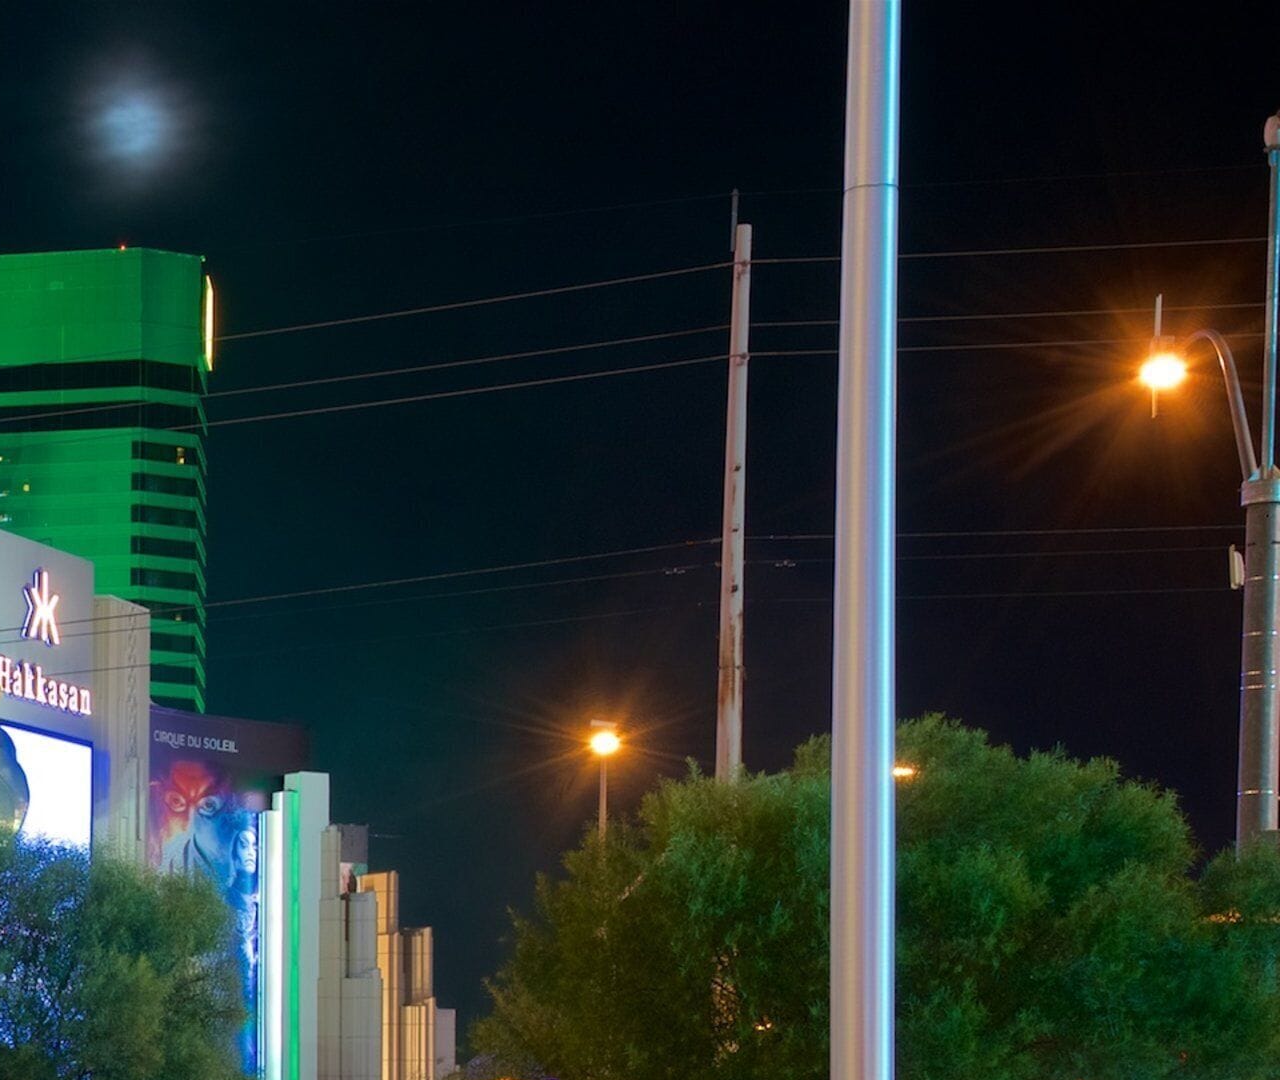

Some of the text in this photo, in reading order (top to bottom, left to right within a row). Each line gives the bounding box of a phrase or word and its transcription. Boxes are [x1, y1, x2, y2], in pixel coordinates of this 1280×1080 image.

[153, 729, 239, 753] CIRQUE DU SOLEIL
